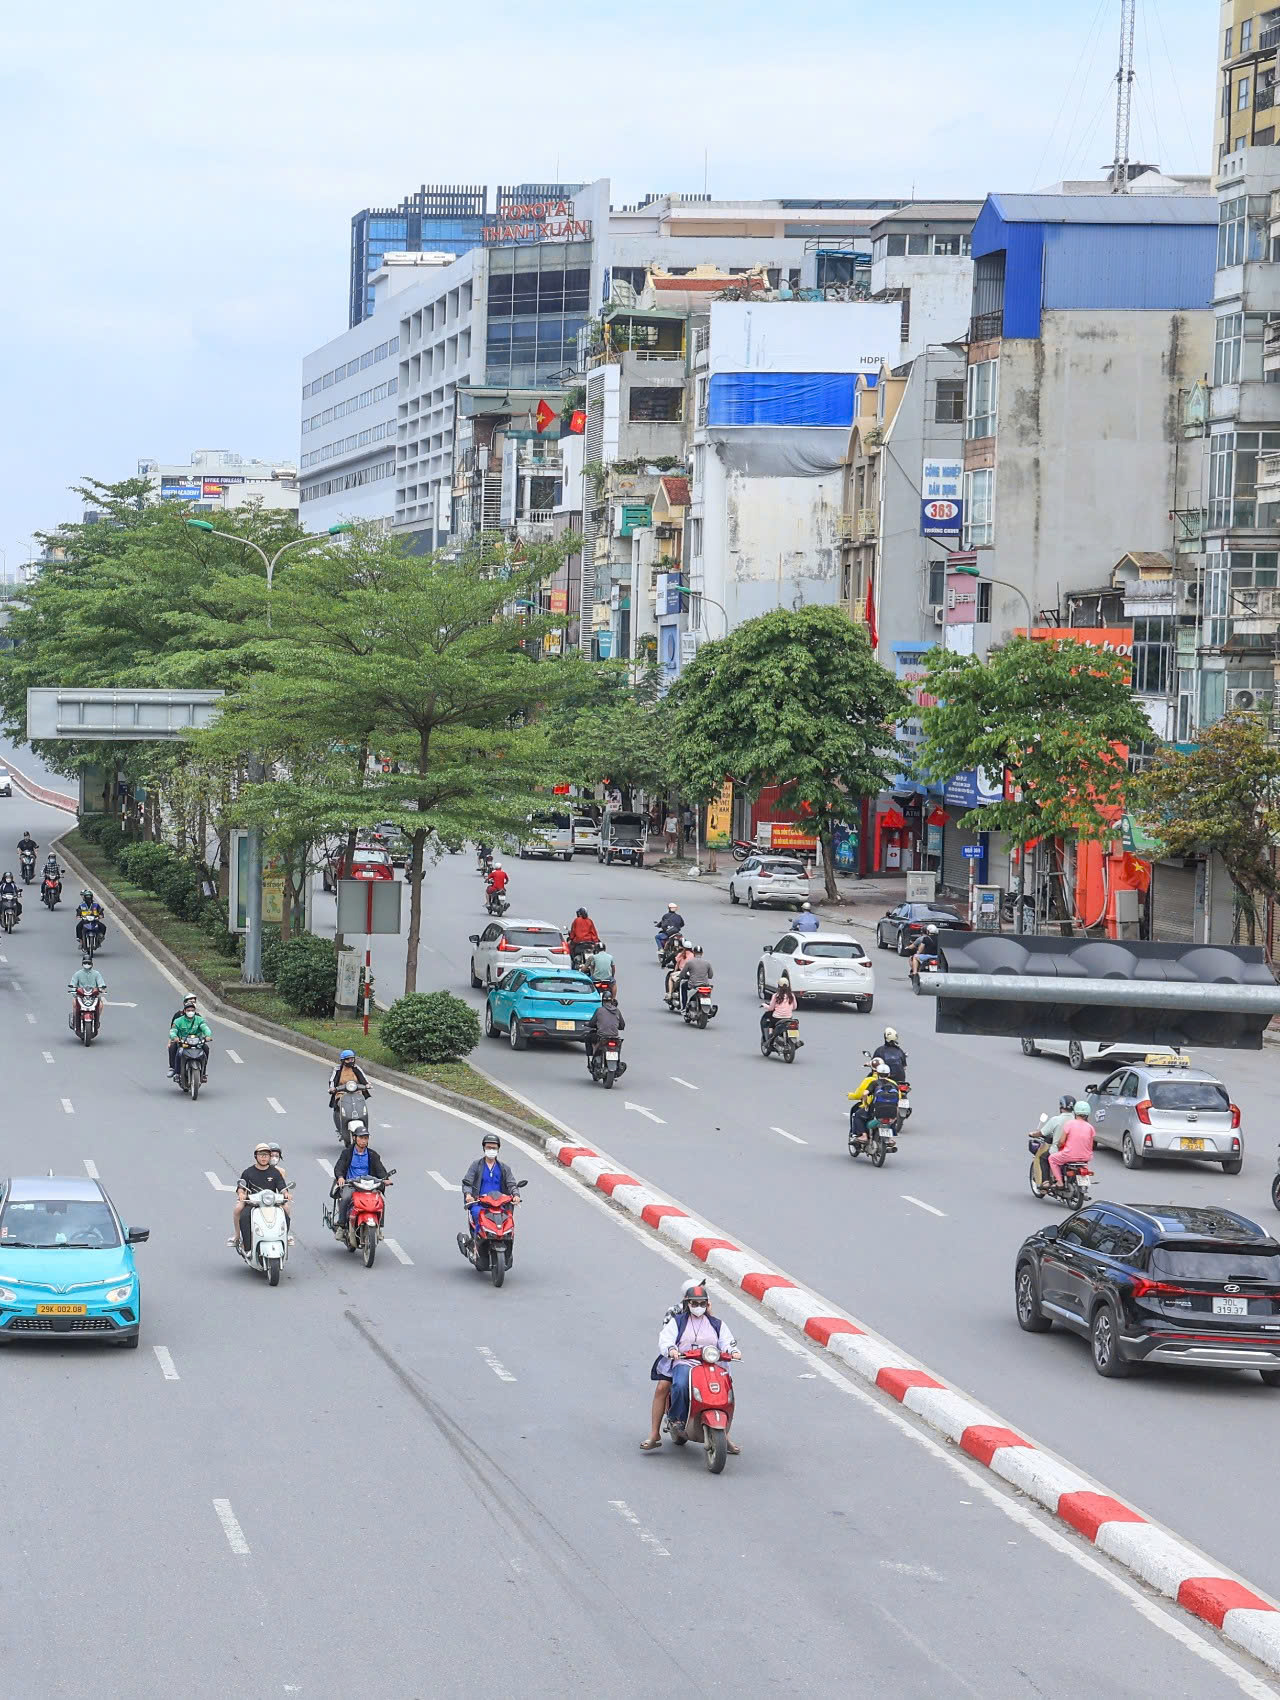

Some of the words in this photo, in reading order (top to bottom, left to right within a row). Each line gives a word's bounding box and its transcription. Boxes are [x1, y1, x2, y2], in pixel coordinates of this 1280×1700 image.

[499, 201, 567, 220] TOYOTA
[482, 224, 536, 241] THANH
[540, 219, 586, 237] XUÂN
[860, 356, 885, 364] HDPE
[930, 503, 952, 518] 363
